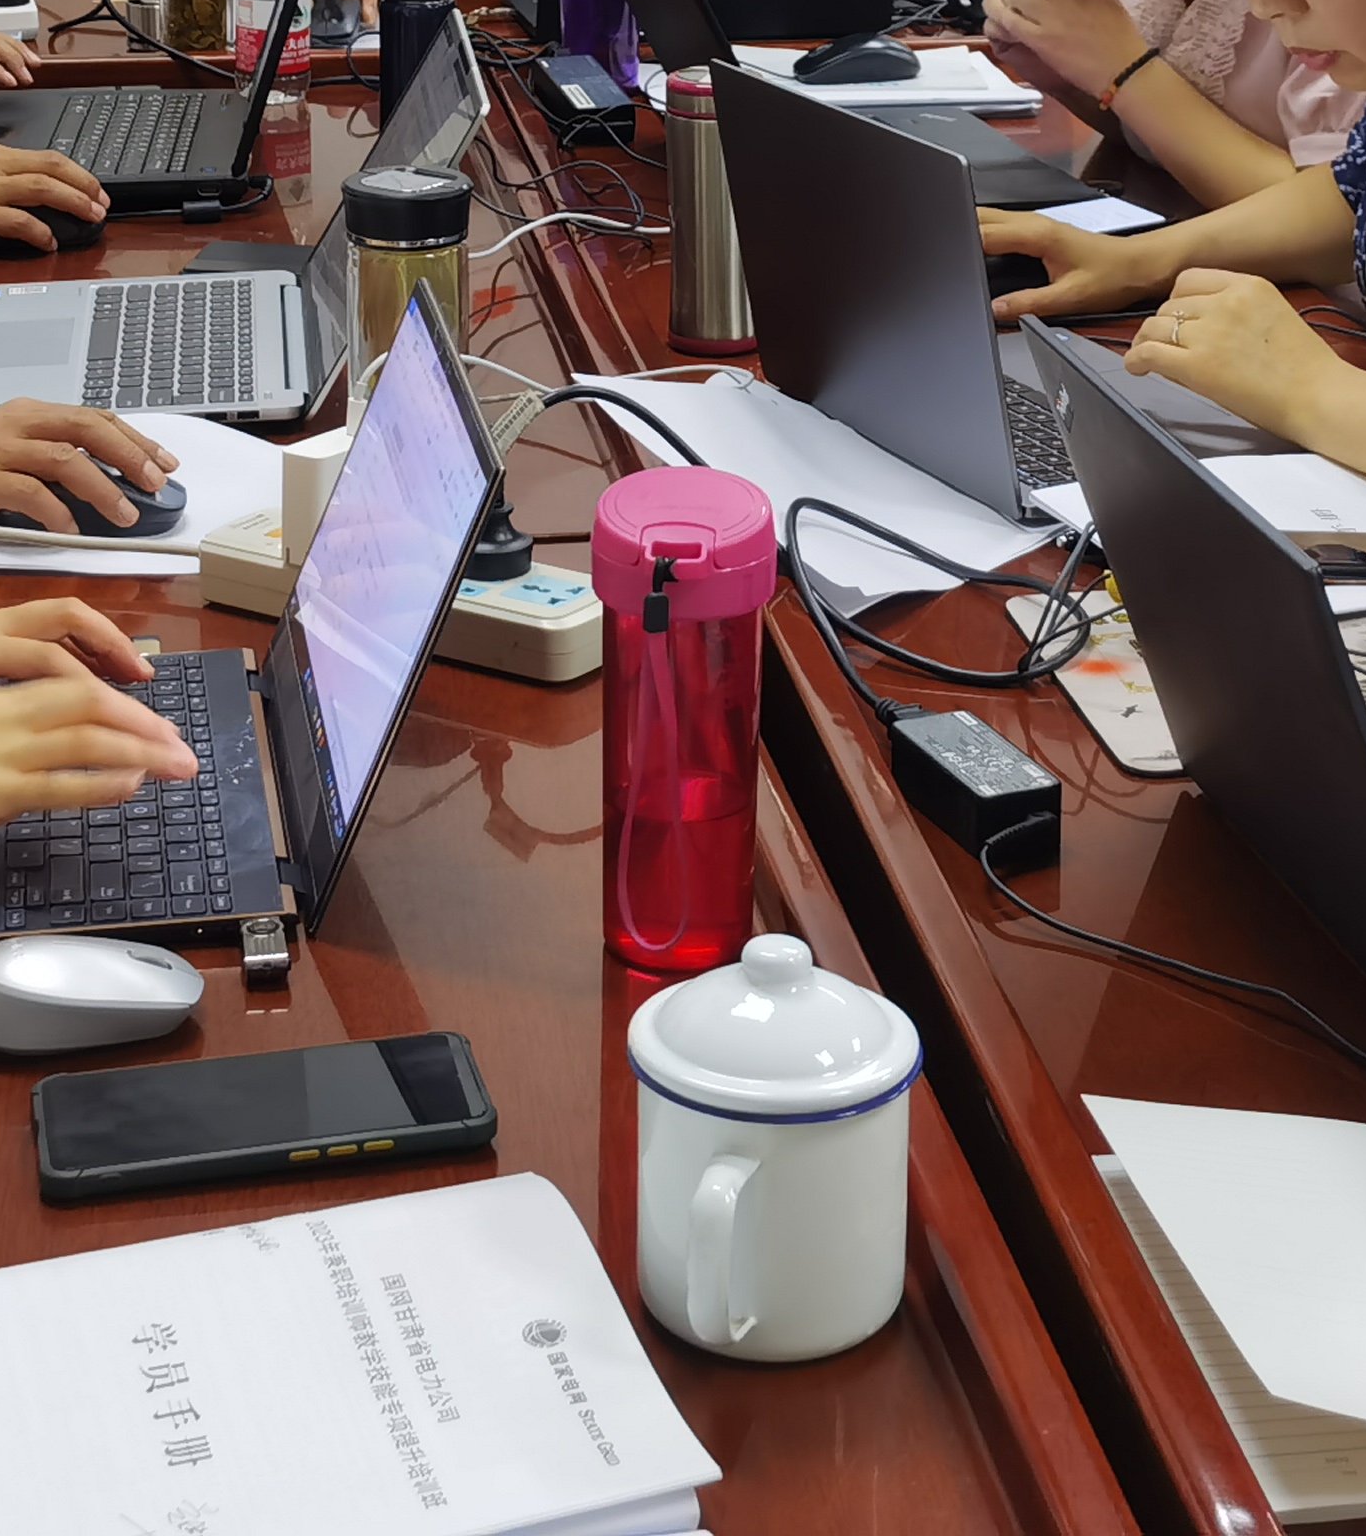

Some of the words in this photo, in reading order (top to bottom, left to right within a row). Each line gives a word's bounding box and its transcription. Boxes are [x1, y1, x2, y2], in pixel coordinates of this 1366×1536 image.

[131, 1323, 213, 1467] 学员手册
[306, 1219, 448, 1510] 2023年兼职培训师教学技能专项提升培训班
[380, 1273, 461, 1424] 国网甘肃省电力公司
[547, 1351, 587, 1405] 国家电网
